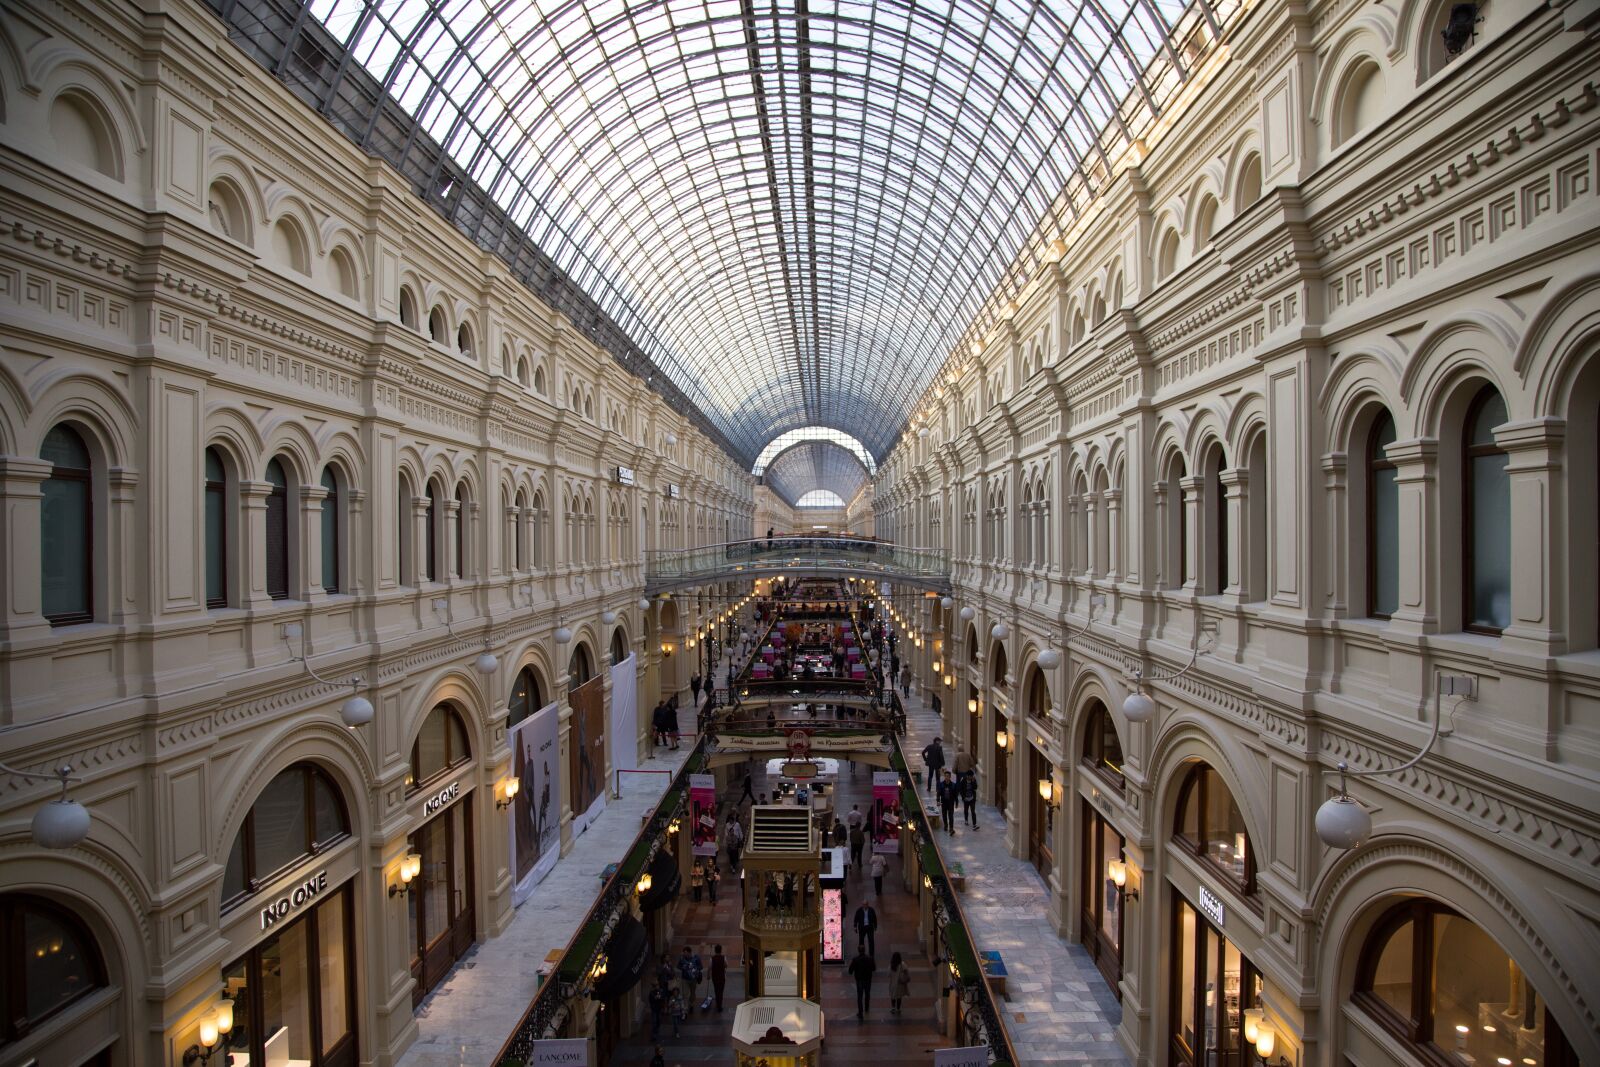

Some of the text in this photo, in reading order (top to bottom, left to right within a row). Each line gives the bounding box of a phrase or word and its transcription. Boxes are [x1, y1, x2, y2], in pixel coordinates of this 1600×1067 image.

[423, 781, 459, 817] NO ONE
[261, 870, 328, 930] NO ONE
